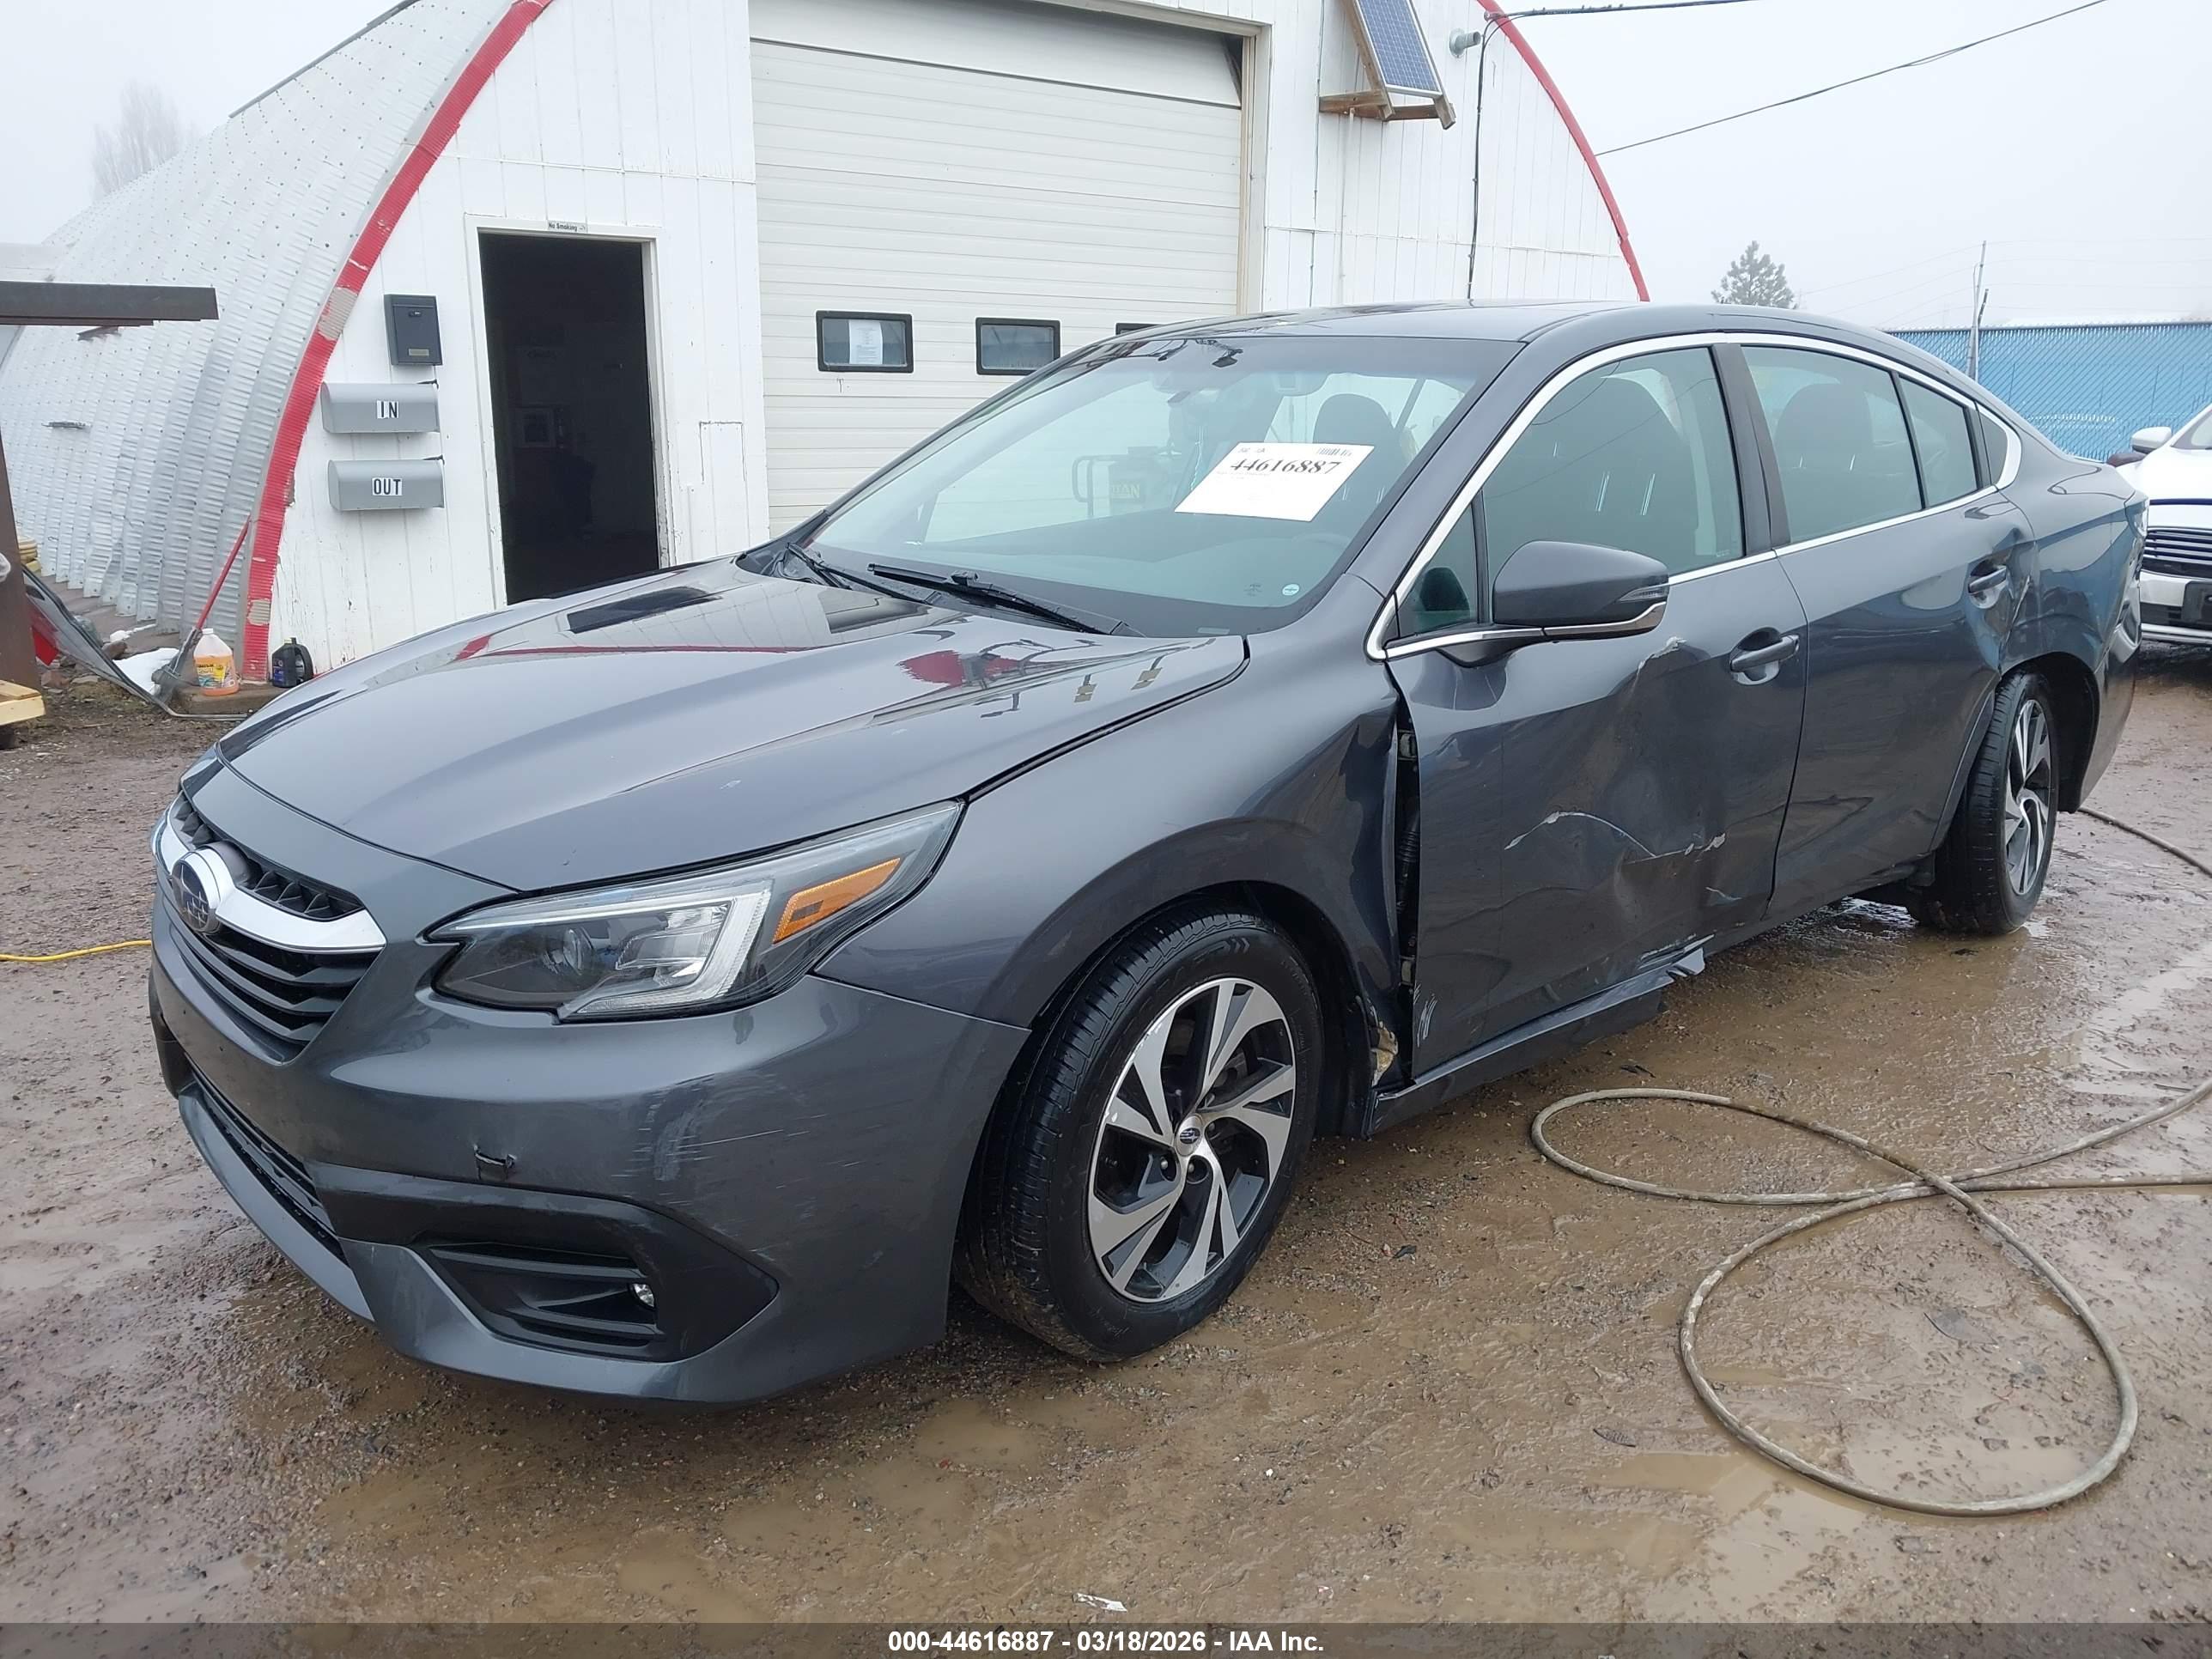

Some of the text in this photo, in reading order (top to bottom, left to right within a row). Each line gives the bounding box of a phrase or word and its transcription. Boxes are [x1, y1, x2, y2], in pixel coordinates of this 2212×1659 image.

[556, 222, 578, 233] Smoking
[380, 401, 398, 418] IN
[1231, 458, 1342, 475] 44616887
[374, 478, 402, 495] OUT
